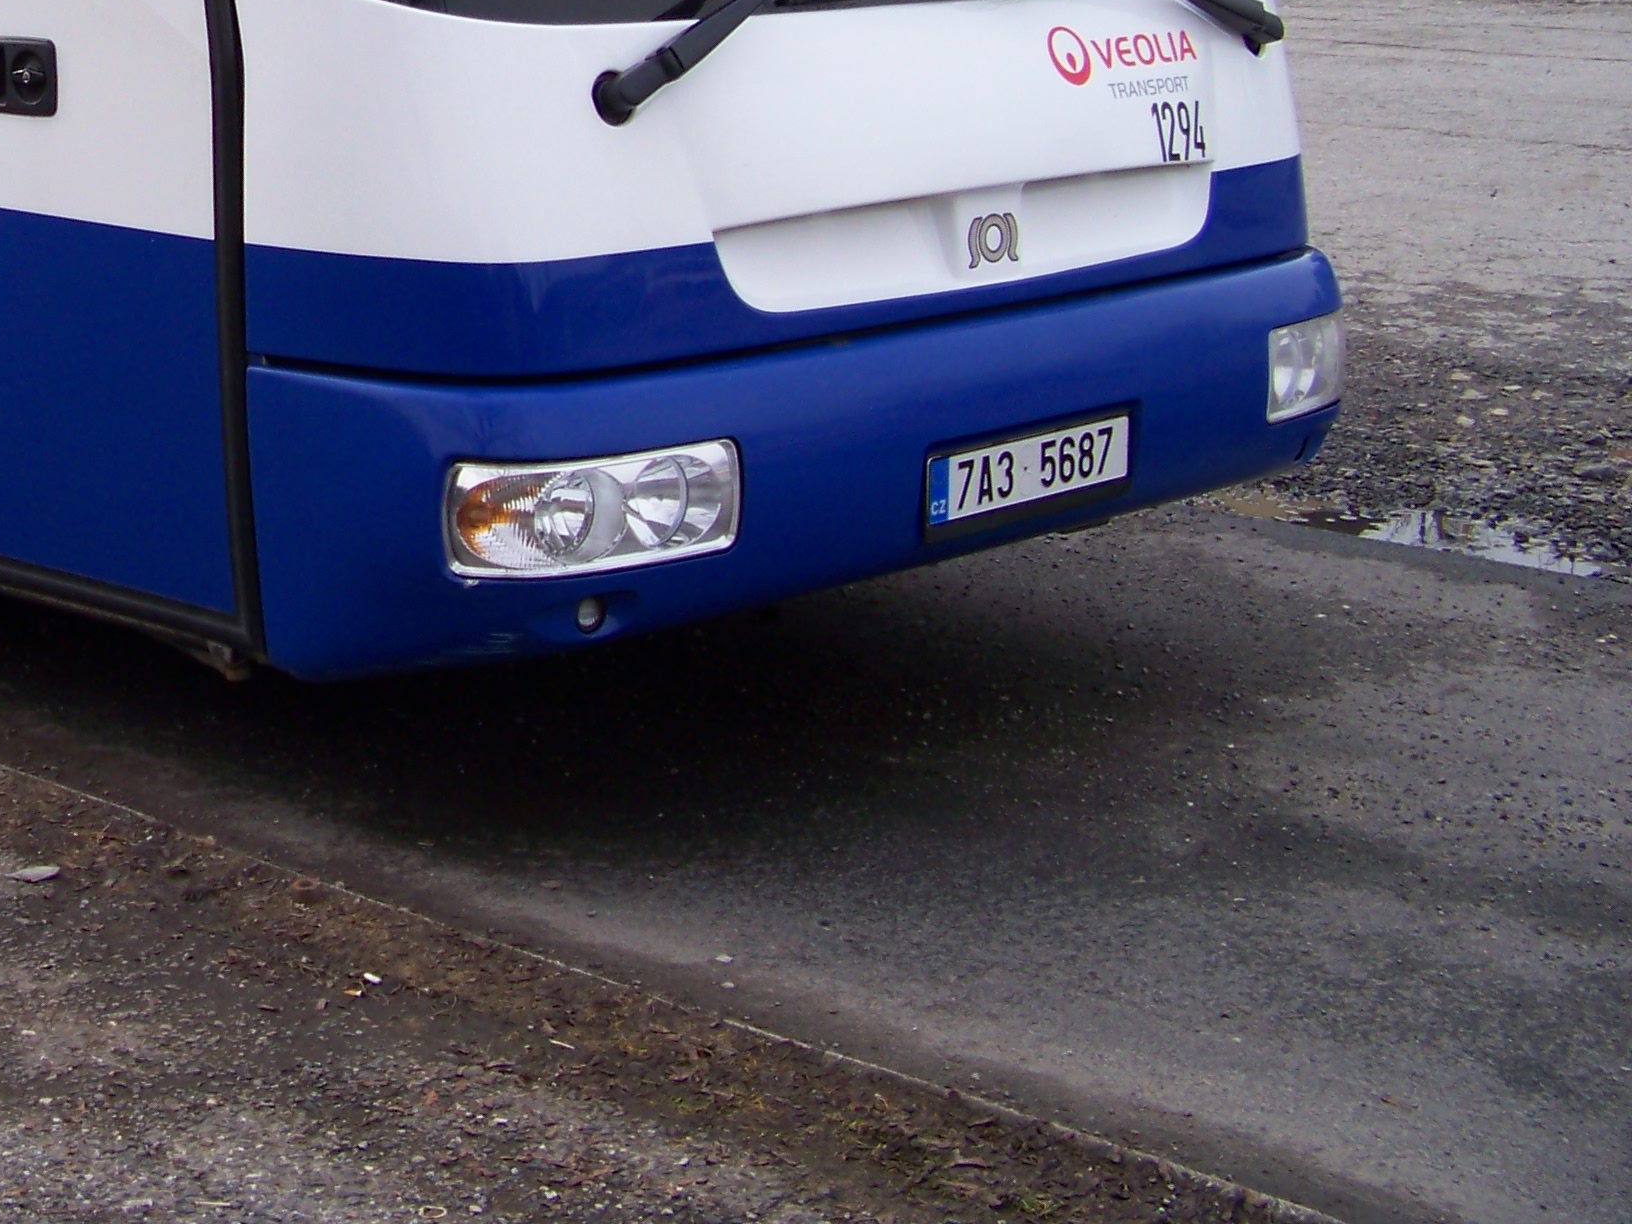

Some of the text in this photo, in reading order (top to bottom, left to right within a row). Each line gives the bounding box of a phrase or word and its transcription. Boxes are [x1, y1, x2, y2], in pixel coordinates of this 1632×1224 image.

[1090, 30, 1197, 69] VEOLIA
[1108, 76, 1189, 99] TRANSPORT
[1151, 100, 1206, 162] 1294
[957, 426, 1113, 511] 7A3 5687
[930, 499, 947, 516] CZ
